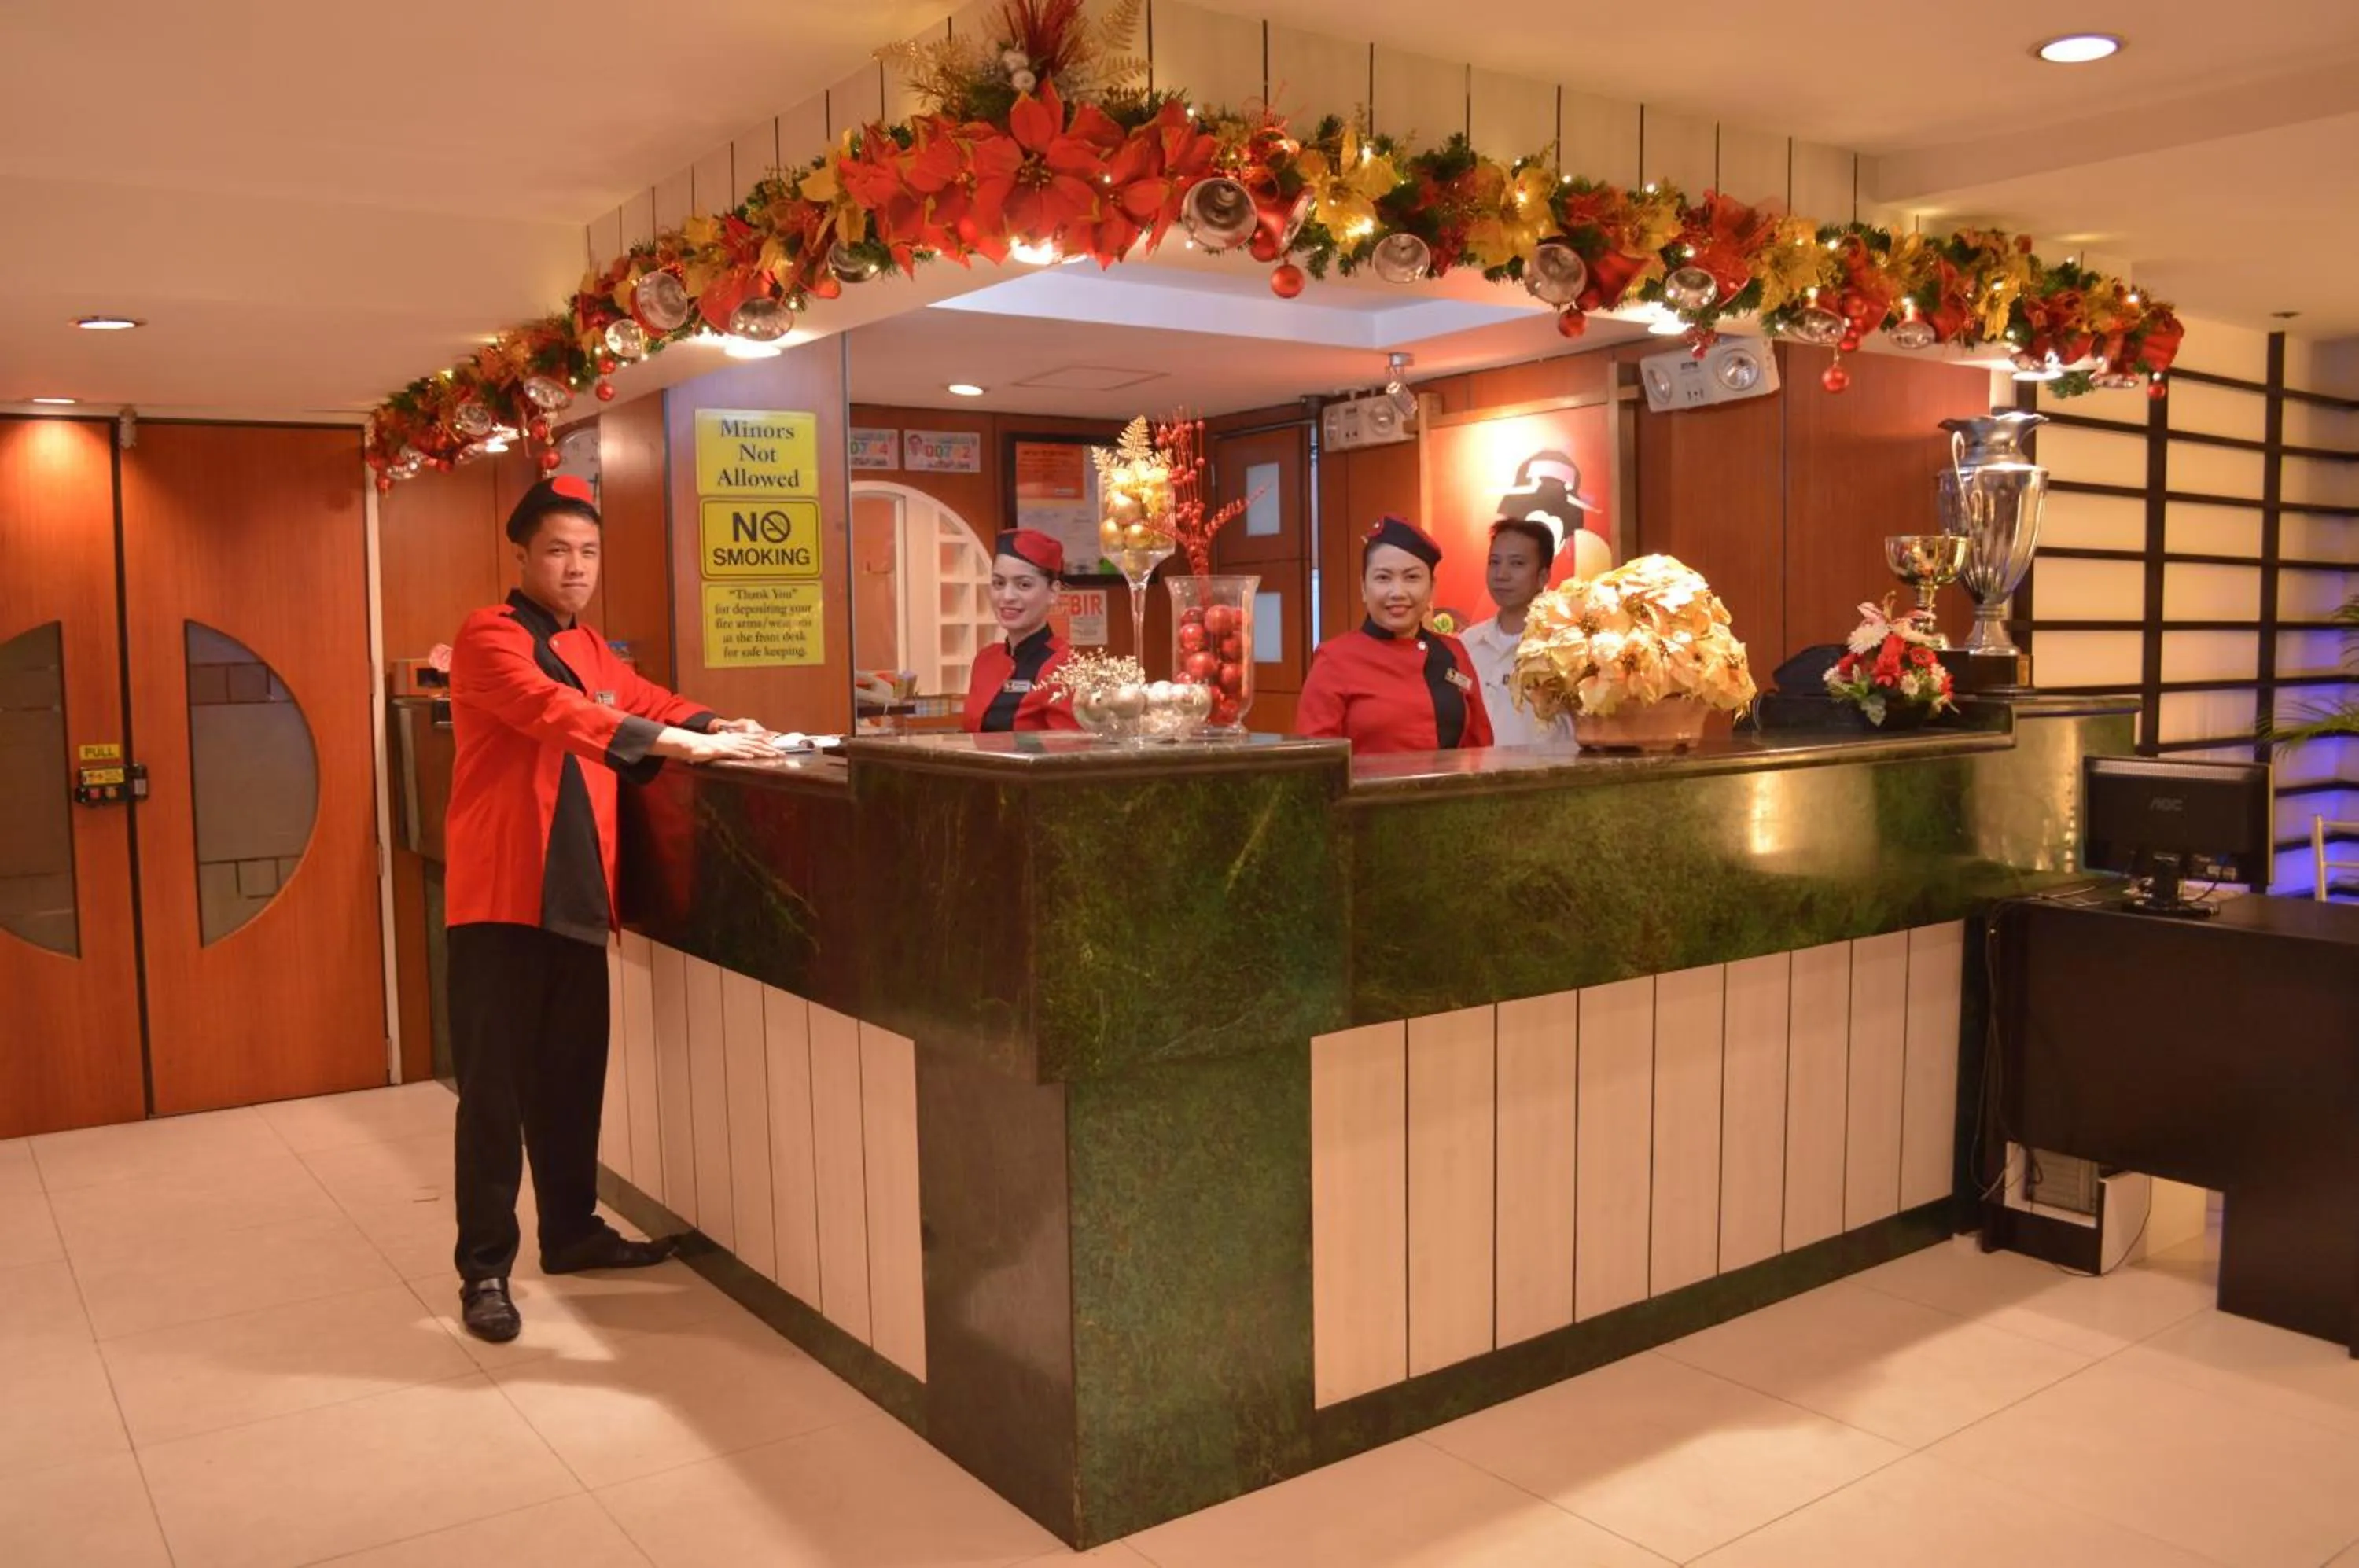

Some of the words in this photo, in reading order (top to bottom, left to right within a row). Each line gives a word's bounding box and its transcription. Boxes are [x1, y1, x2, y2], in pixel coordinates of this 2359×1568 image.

[720, 419, 795, 440] Minors
[739, 444, 777, 464] Not
[717, 469, 800, 488] Allowed
[713, 548, 811, 567] SMOKING
[715, 603, 729, 615] for
[732, 602, 787, 617] depositing
[789, 604, 812, 617] your
[1070, 594, 1102, 615] BIR
[715, 617, 734, 629] fire
[736, 617, 812, 630] arms/weaons
[723, 633, 733, 643] at
[736, 631, 753, 643] the
[755, 631, 780, 642] front
[782, 631, 807, 642] desk
[724, 646, 739, 658] for
[742, 646, 761, 657] safe
[85, 747, 115, 758] PULL
[2149, 797, 2183, 811] AOC
